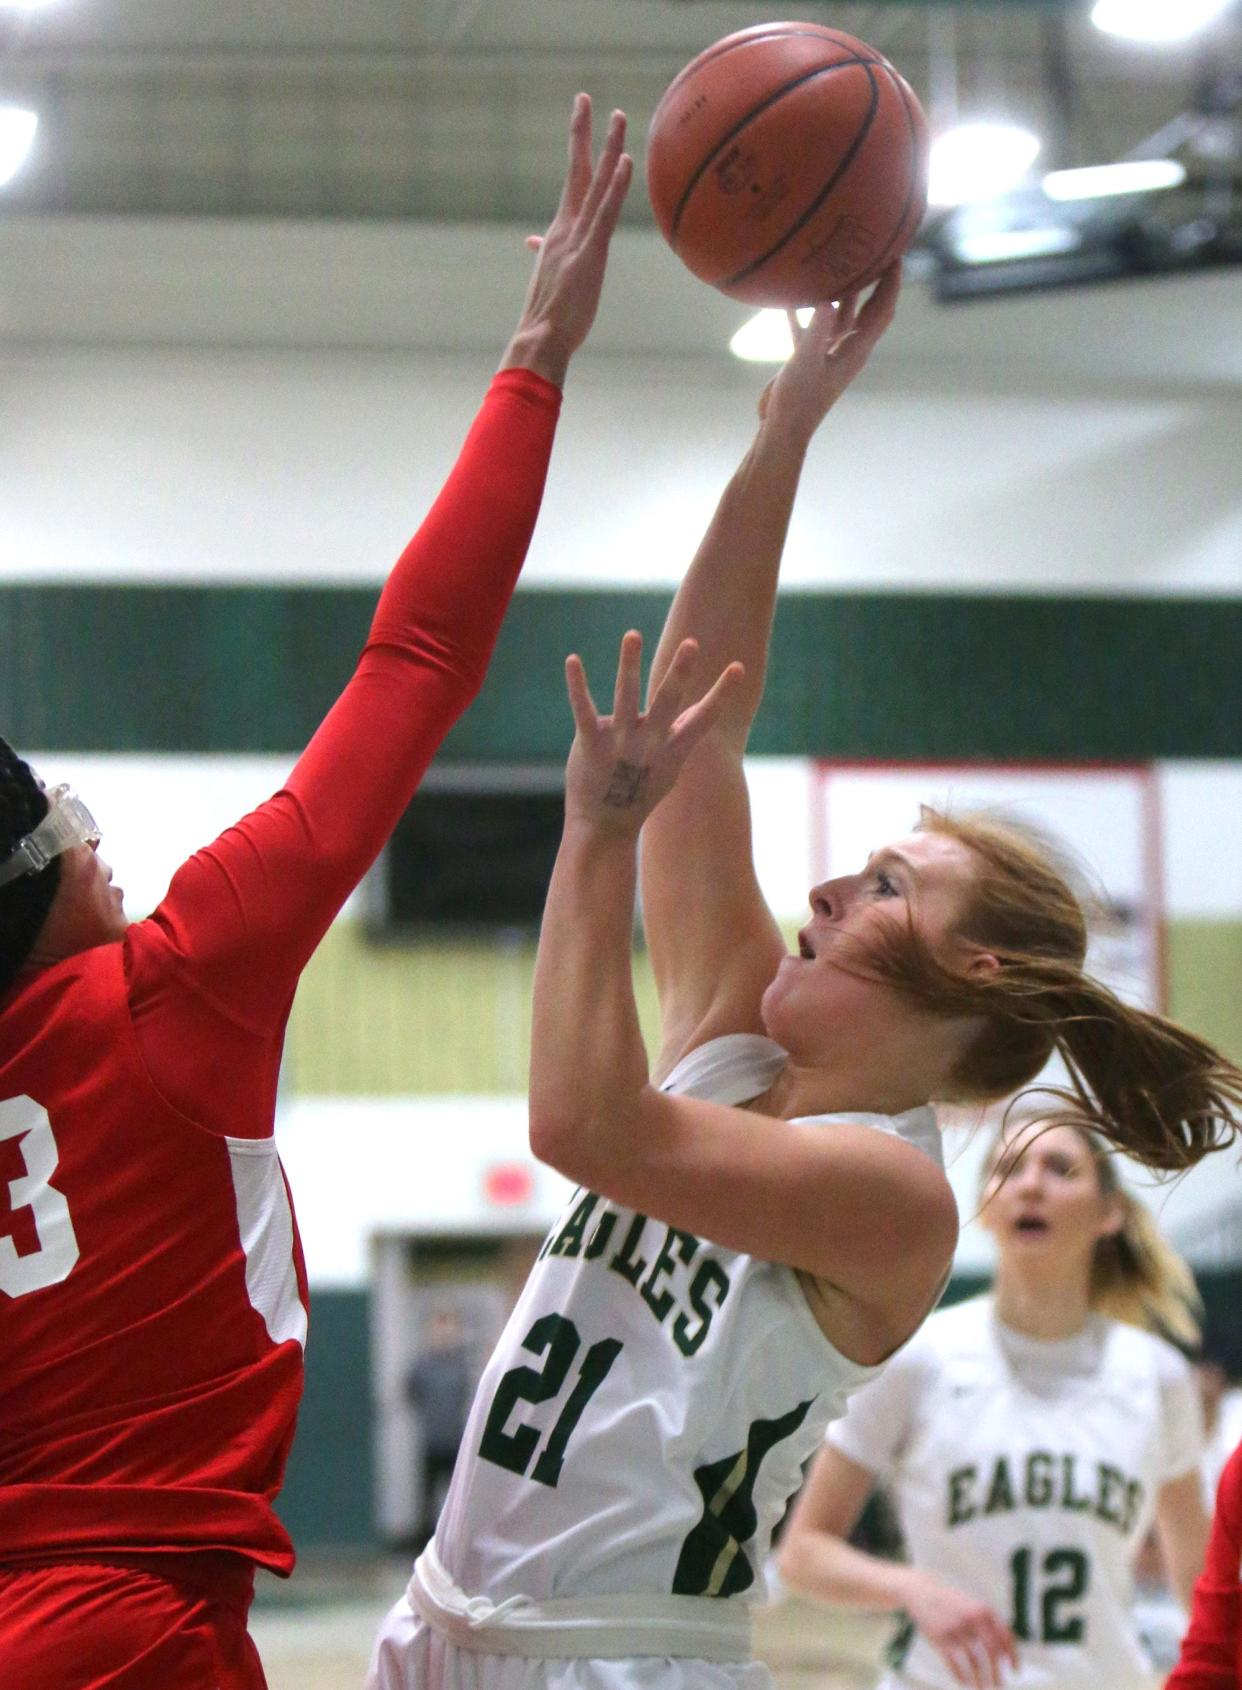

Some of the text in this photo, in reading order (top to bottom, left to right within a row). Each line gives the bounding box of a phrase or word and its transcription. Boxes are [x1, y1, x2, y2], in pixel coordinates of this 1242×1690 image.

[0, 1094, 80, 1298] 3
[478, 1312, 624, 1488] 21
[1010, 1546, 1088, 1642] 12
